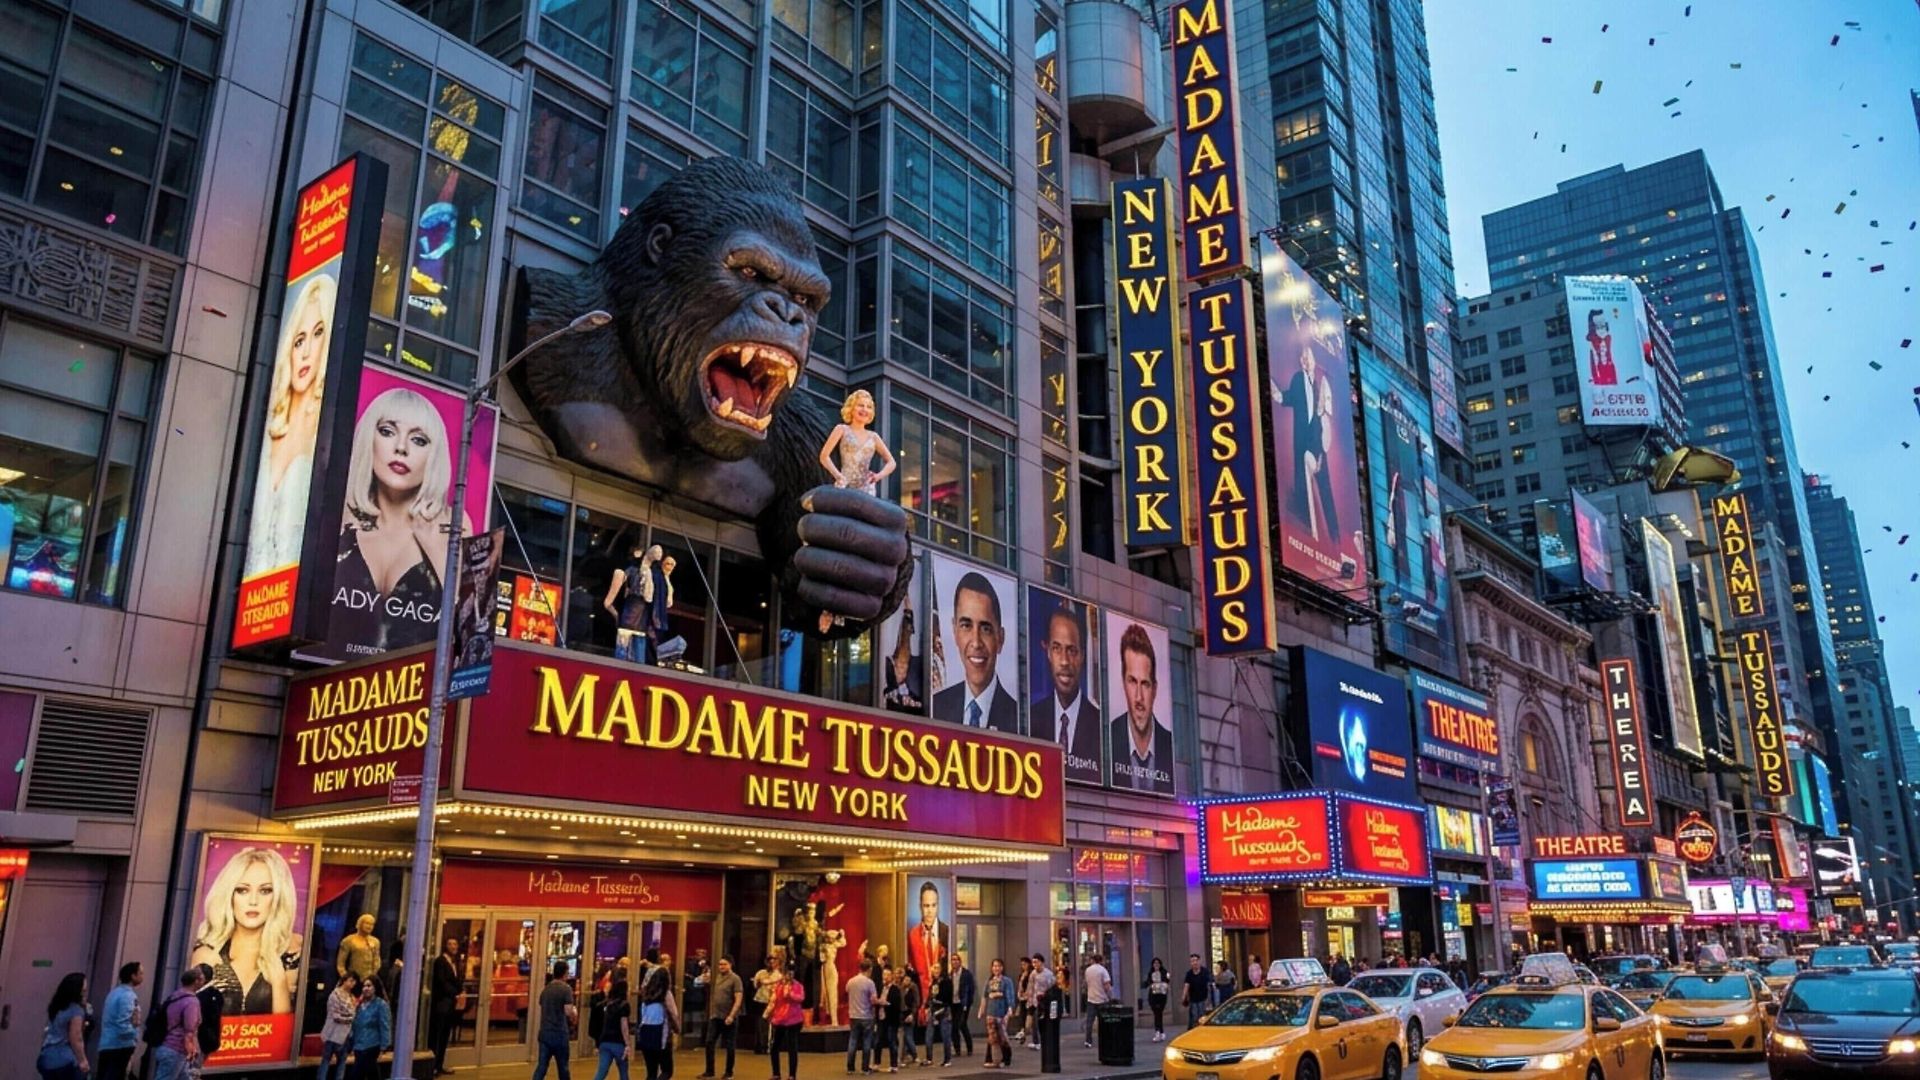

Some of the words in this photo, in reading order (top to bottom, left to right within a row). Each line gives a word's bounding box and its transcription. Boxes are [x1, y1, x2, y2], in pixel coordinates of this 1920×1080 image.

[1176, 0, 1234, 268] MADAME
[1119, 188, 1167, 315] NEW
[1129, 350, 1173, 532] YORK
[1199, 292, 1251, 643] TUSSAUDS
[1716, 498, 1755, 616] MADAME
[1740, 632, 1784, 794] TUSSAUDS
[306, 662, 426, 722] MADAME
[296, 707, 430, 766] TUSSAUDS
[533, 666, 810, 768] MADAME
[823, 716, 1044, 800] TUSSAUDS
[312, 768, 349, 794] NEW
[352, 760, 398, 788] YORK
[745, 774, 818, 812] NEW
[829, 784, 909, 822] YORK
[1221, 807, 1301, 833] Madame
[1535, 835, 1625, 856] THEATRE
[528, 870, 590, 894] Madame
